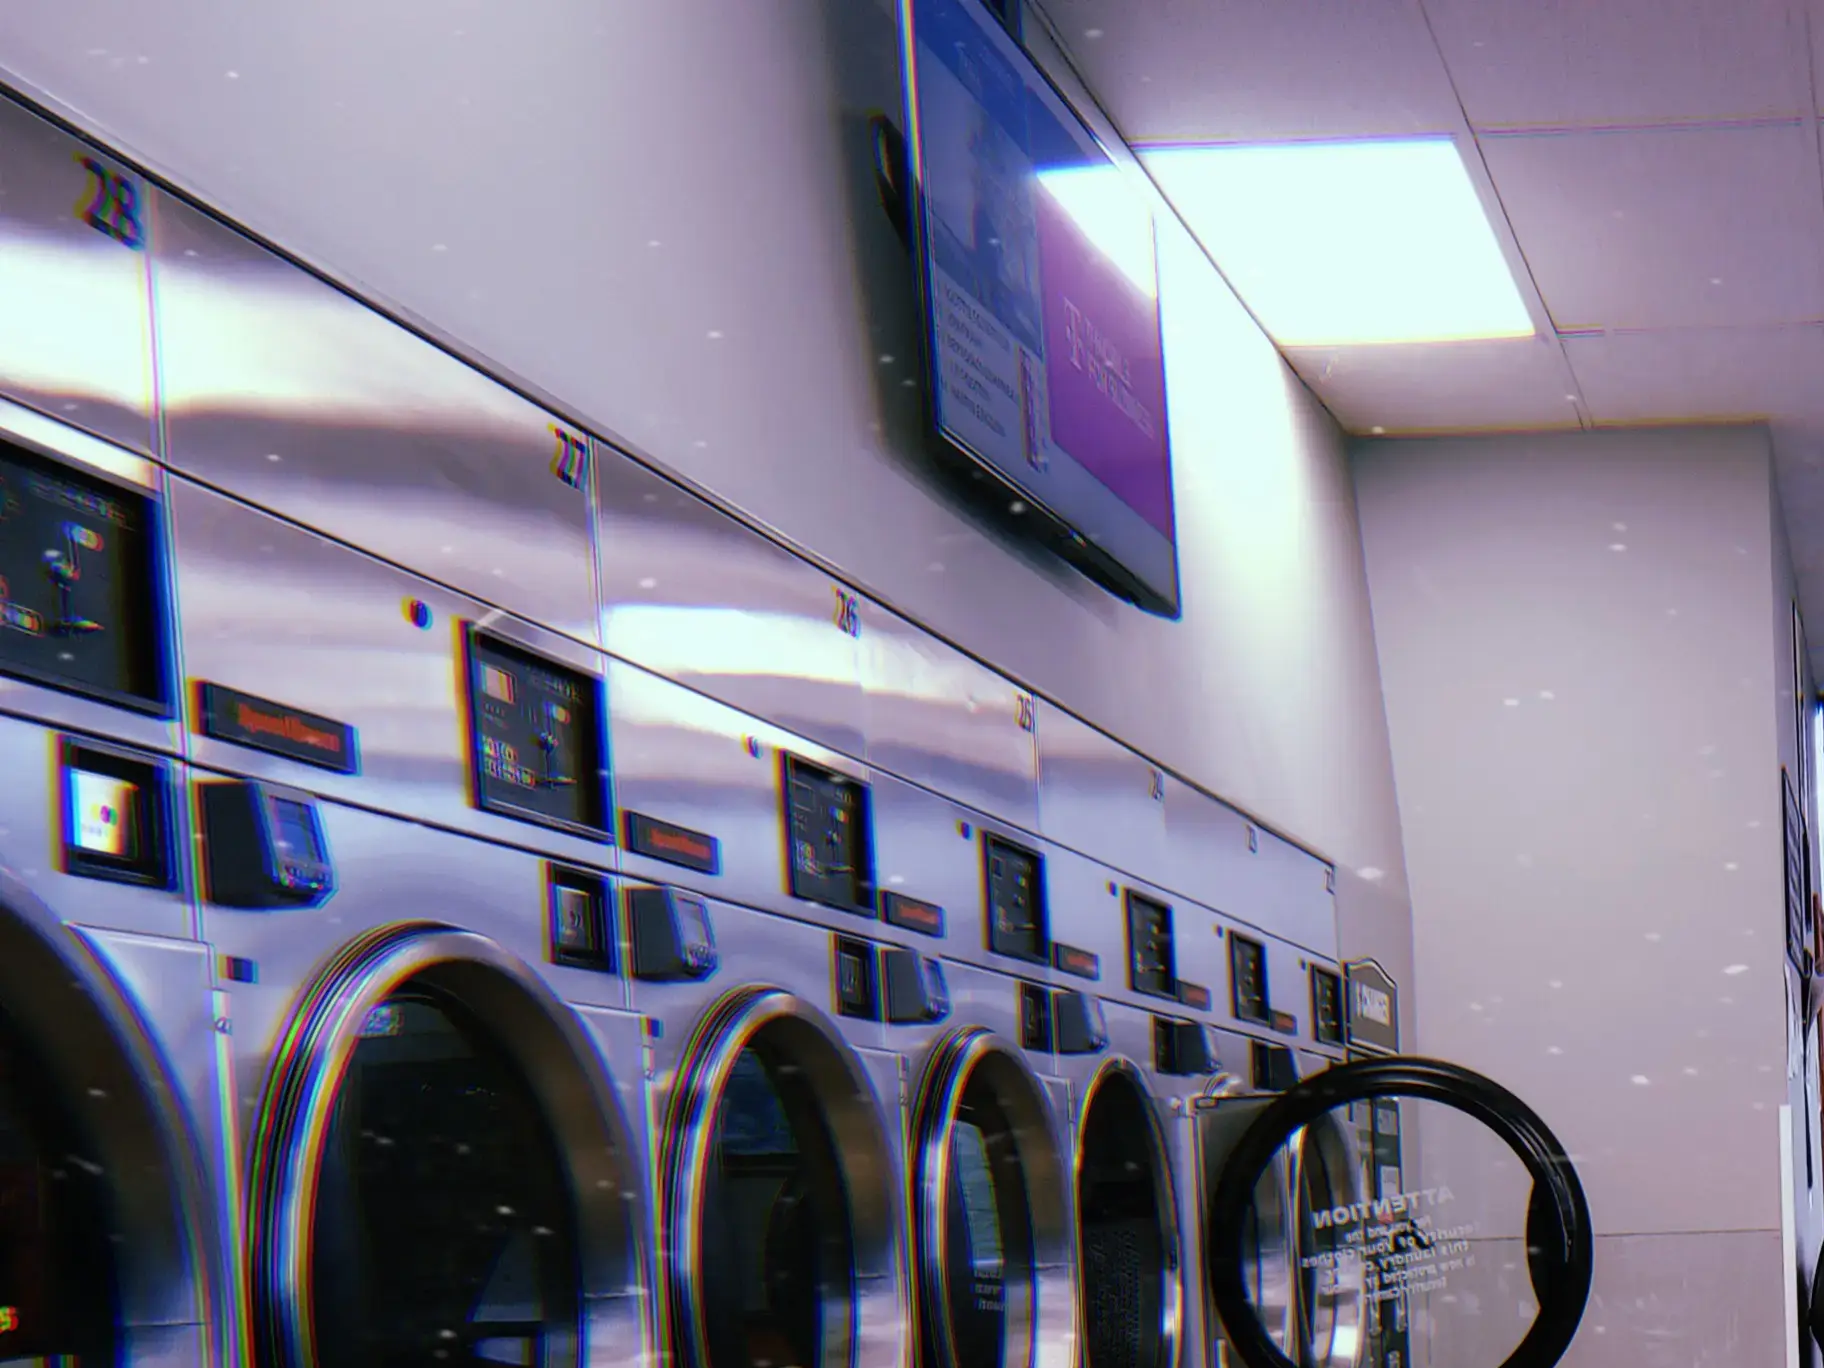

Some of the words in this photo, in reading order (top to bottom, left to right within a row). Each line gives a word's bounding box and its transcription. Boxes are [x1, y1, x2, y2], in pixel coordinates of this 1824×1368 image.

[74, 153, 142, 248] 28
[551, 426, 588, 489] 27
[834, 586, 860, 638] 26
